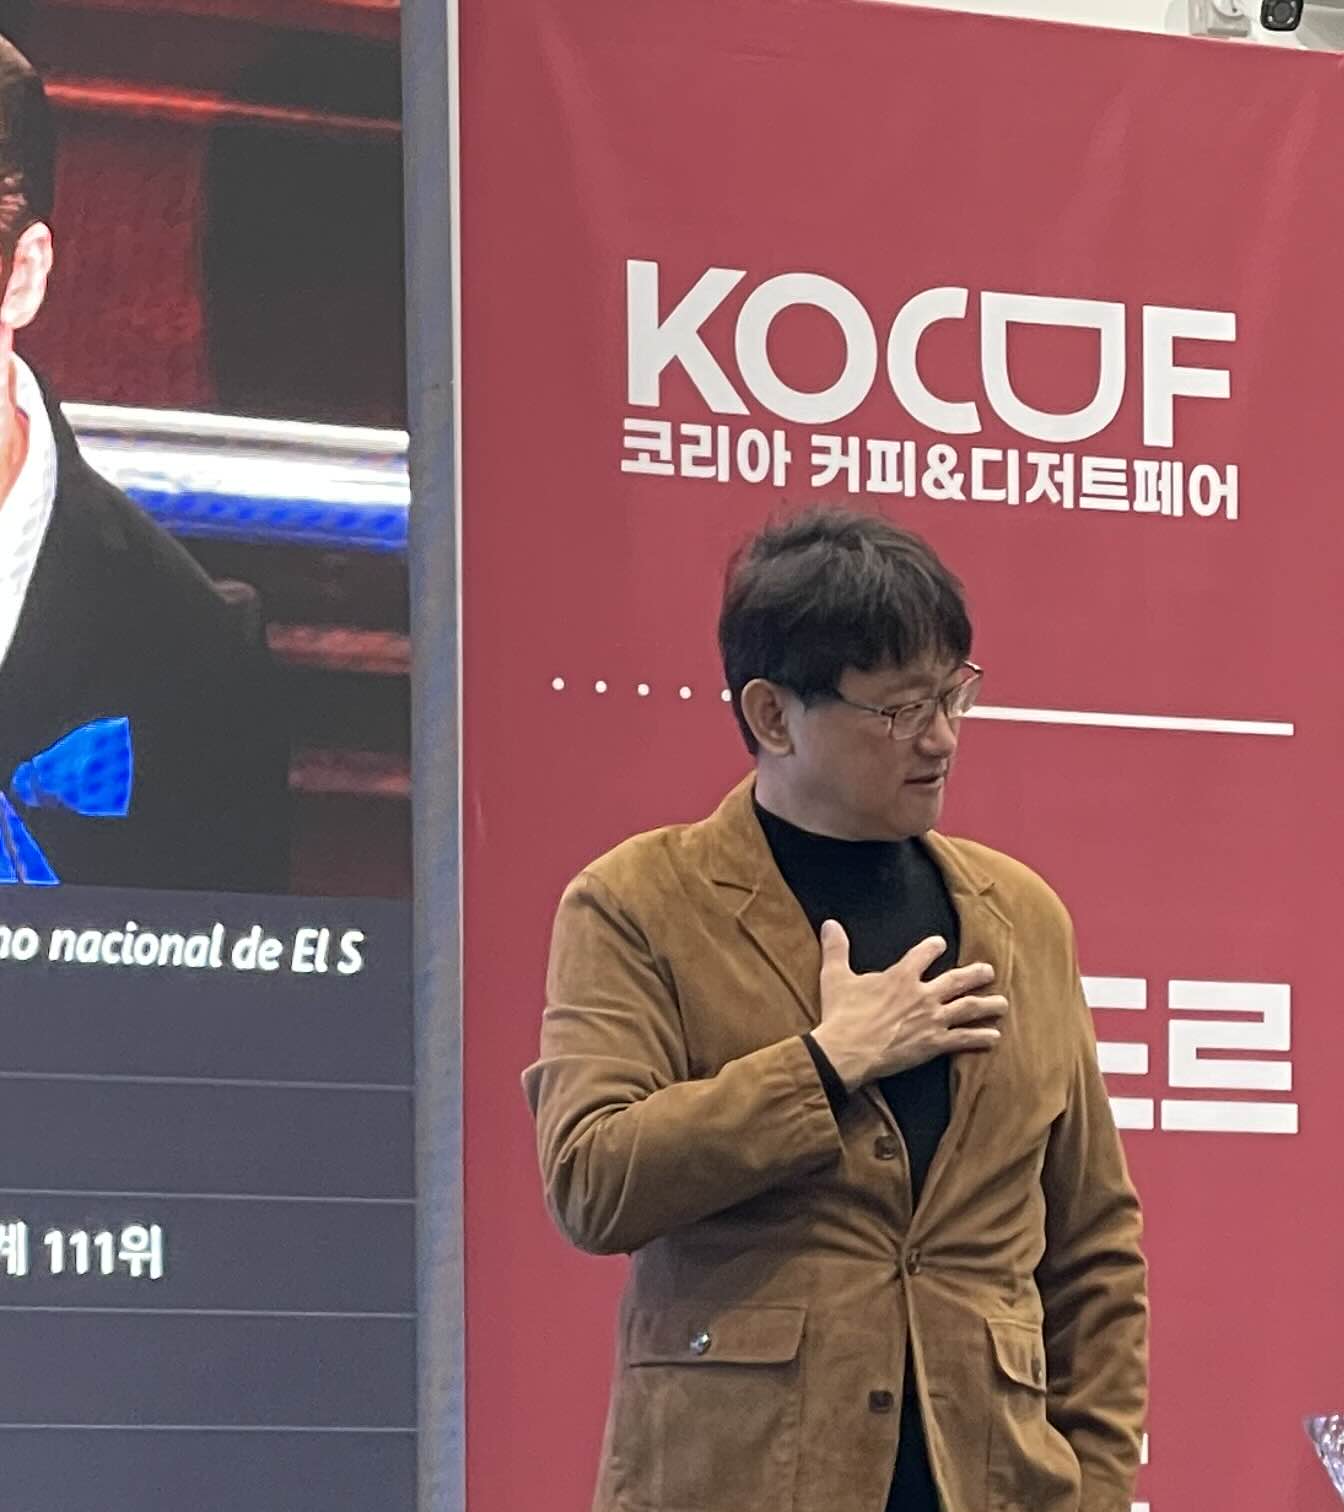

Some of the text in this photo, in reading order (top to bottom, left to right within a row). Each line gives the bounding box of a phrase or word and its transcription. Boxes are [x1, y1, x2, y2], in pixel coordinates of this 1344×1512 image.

[620, 418, 1239, 521] 코리아 커피&디저트페어
[48, 921, 223, 968] nacional
[233, 926, 284, 971] de
[291, 929, 327, 974] El
[338, 930, 365, 976] S
[44, 1224, 164, 1280] 111위
